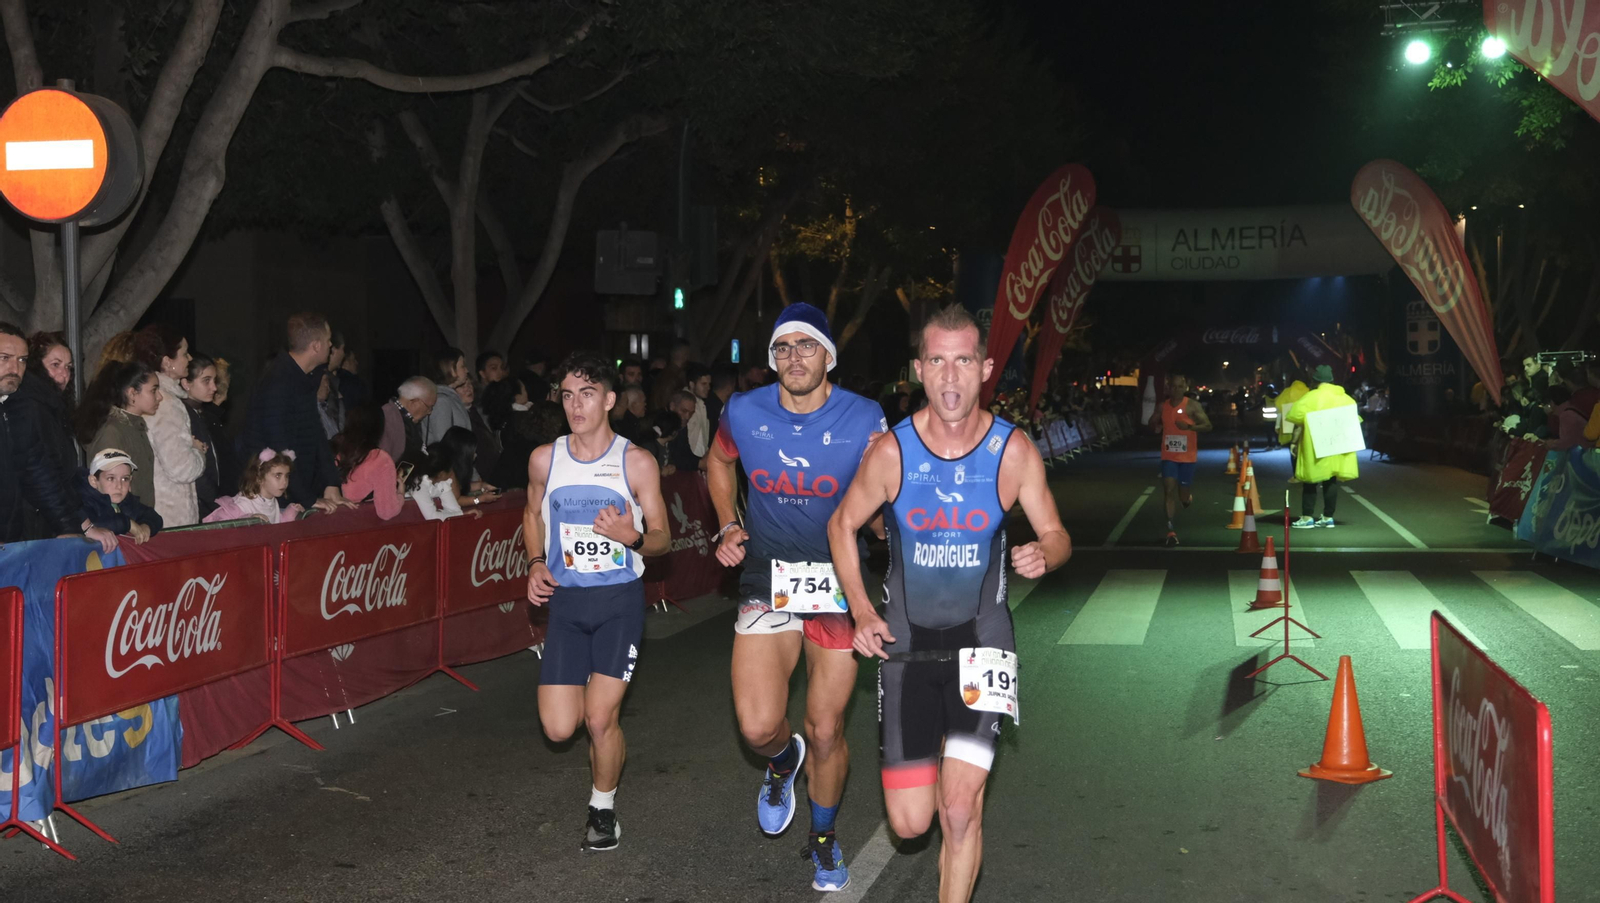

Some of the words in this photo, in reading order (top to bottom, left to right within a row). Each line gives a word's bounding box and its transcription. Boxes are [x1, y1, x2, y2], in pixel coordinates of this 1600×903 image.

[1006, 171, 1089, 320] Coca-Cola
[1171, 219, 1308, 252] ALMERÍA
[1050, 212, 1117, 333] Coca-Cola
[1171, 256, 1240, 270] CIUDAD
[751, 430, 774, 439] SPIRAL
[750, 469, 839, 498] GALO
[907, 472, 941, 483] SPIRAL
[563, 497, 616, 508] Murgiverde
[777, 496, 809, 506] SPORT
[906, 506, 990, 532] GALO
[471, 523, 528, 588] Coca-Co
[574, 541, 611, 556] 693
[913, 539, 981, 568] RODRÍGUEZ
[320, 542, 412, 620] Coca-Cola
[790, 577, 832, 594] 754
[105, 572, 228, 679] Coca-Cola
[1449, 667, 1510, 848] Coca-Cola
